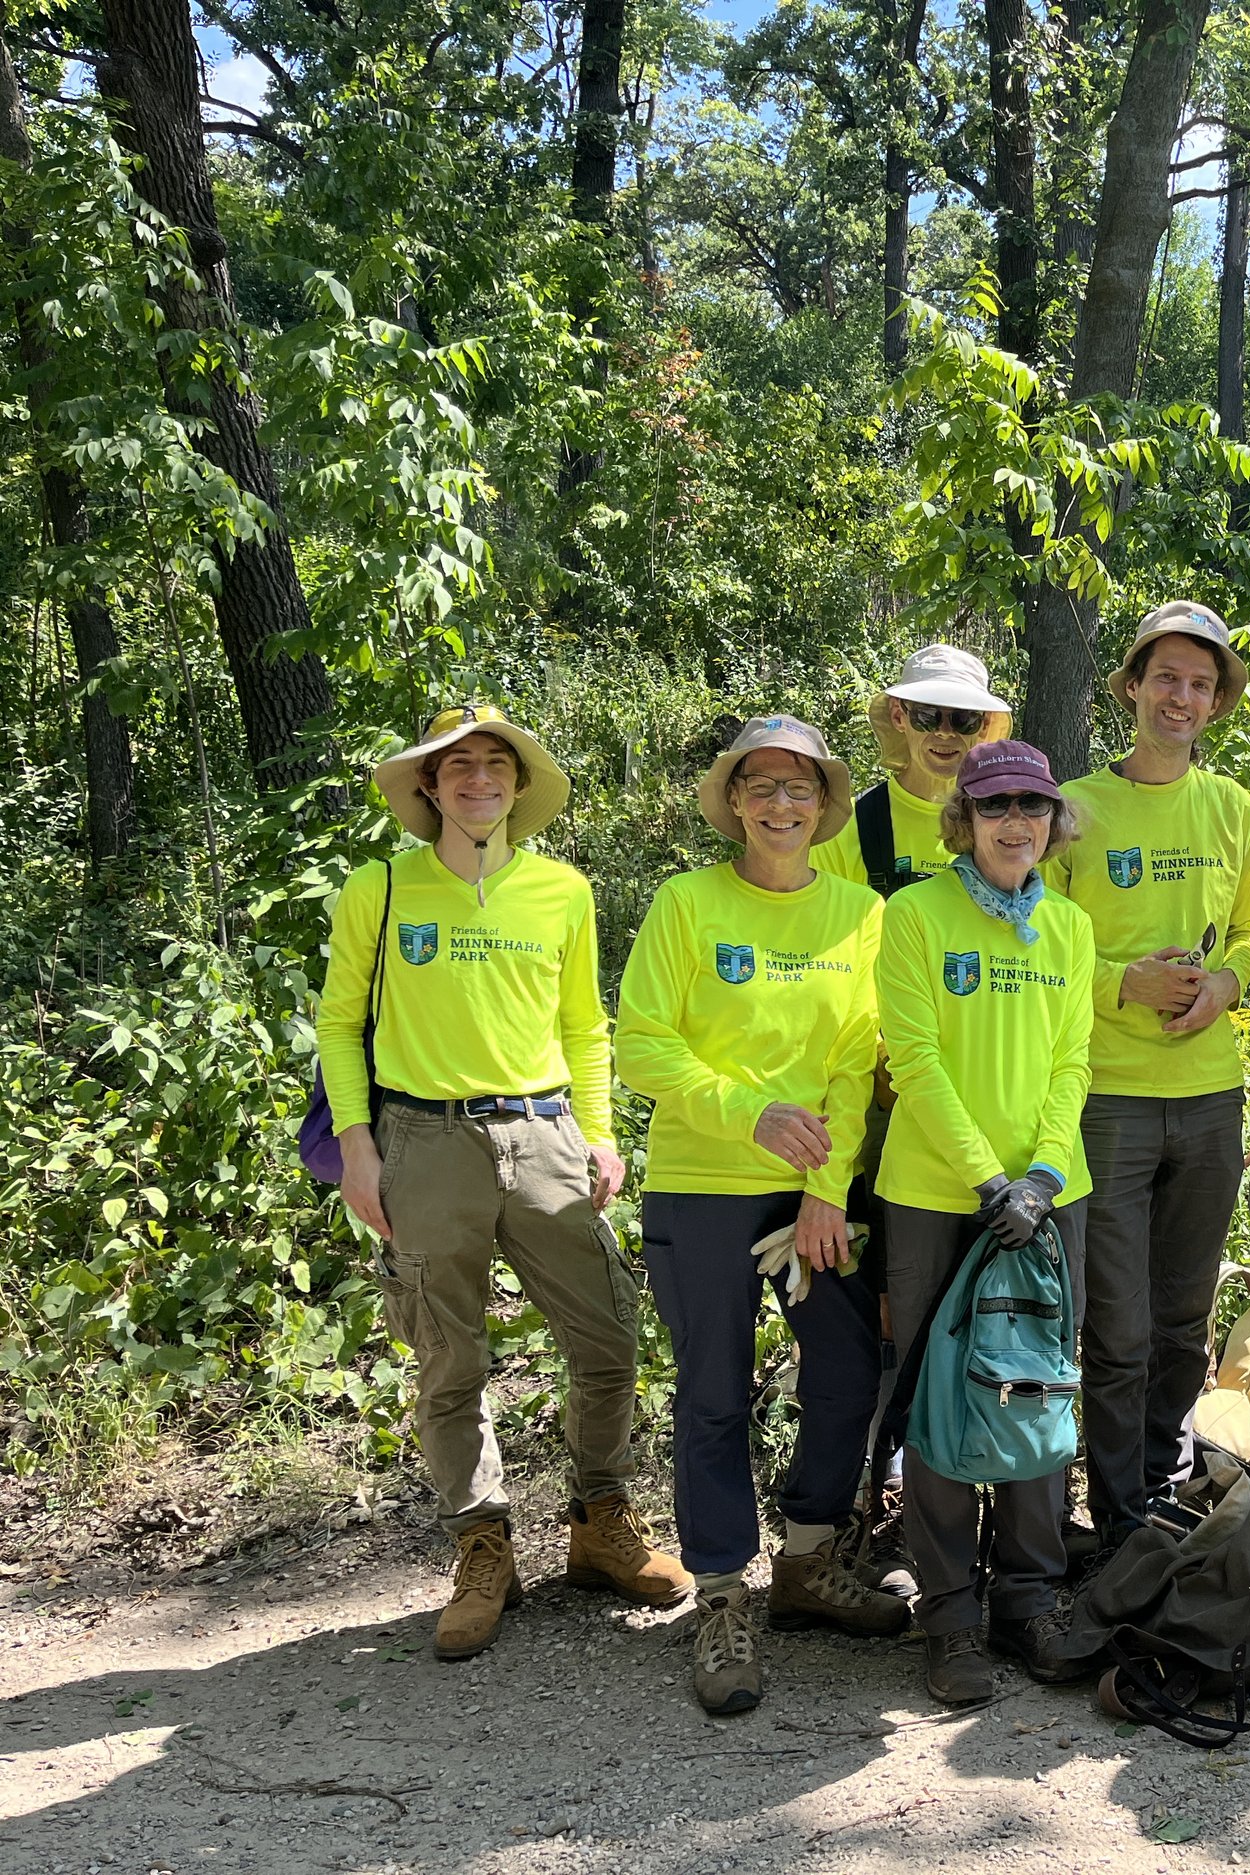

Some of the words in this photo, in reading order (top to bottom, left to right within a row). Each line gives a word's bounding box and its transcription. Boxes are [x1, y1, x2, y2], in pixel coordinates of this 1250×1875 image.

[977, 755, 1023, 769] Buckthorn
[1150, 848, 1181, 857] Friends
[1182, 846, 1190, 855] of
[1151, 857, 1224, 870] MINNEHAHA
[1153, 870, 1186, 882] PARK
[450, 926, 487, 935] Friends
[489, 927, 500, 935] of
[450, 938, 543, 953] MINNEHAHA
[450, 951, 489, 961] PARK
[766, 948, 798, 960] Friends
[800, 952, 810, 960] of
[766, 959, 852, 973] MINNEHAHA
[989, 955, 1020, 965] Friends
[1021, 959, 1030, 967] of
[766, 971, 803, 982] PARK
[989, 968, 1066, 987] MINNEHAHA
[990, 982, 1021, 993] PARK
